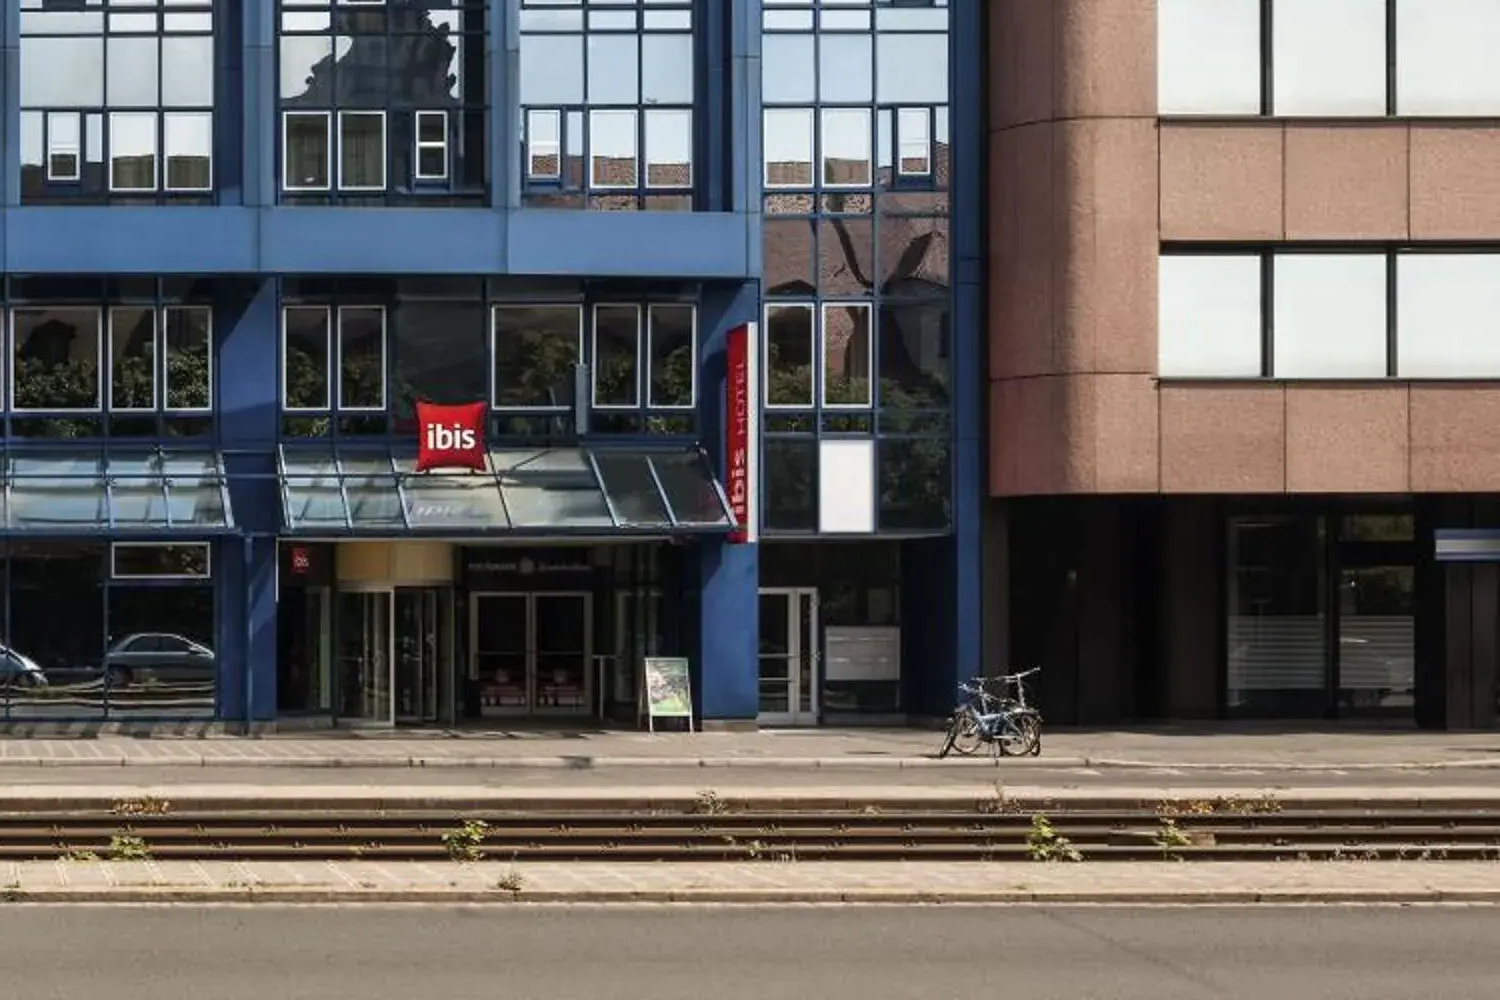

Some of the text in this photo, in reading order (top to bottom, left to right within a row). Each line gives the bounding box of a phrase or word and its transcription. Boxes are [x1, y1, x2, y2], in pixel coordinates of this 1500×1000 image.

[427, 422, 476, 450] ibis
[731, 363, 744, 515] ibis HOTEL
